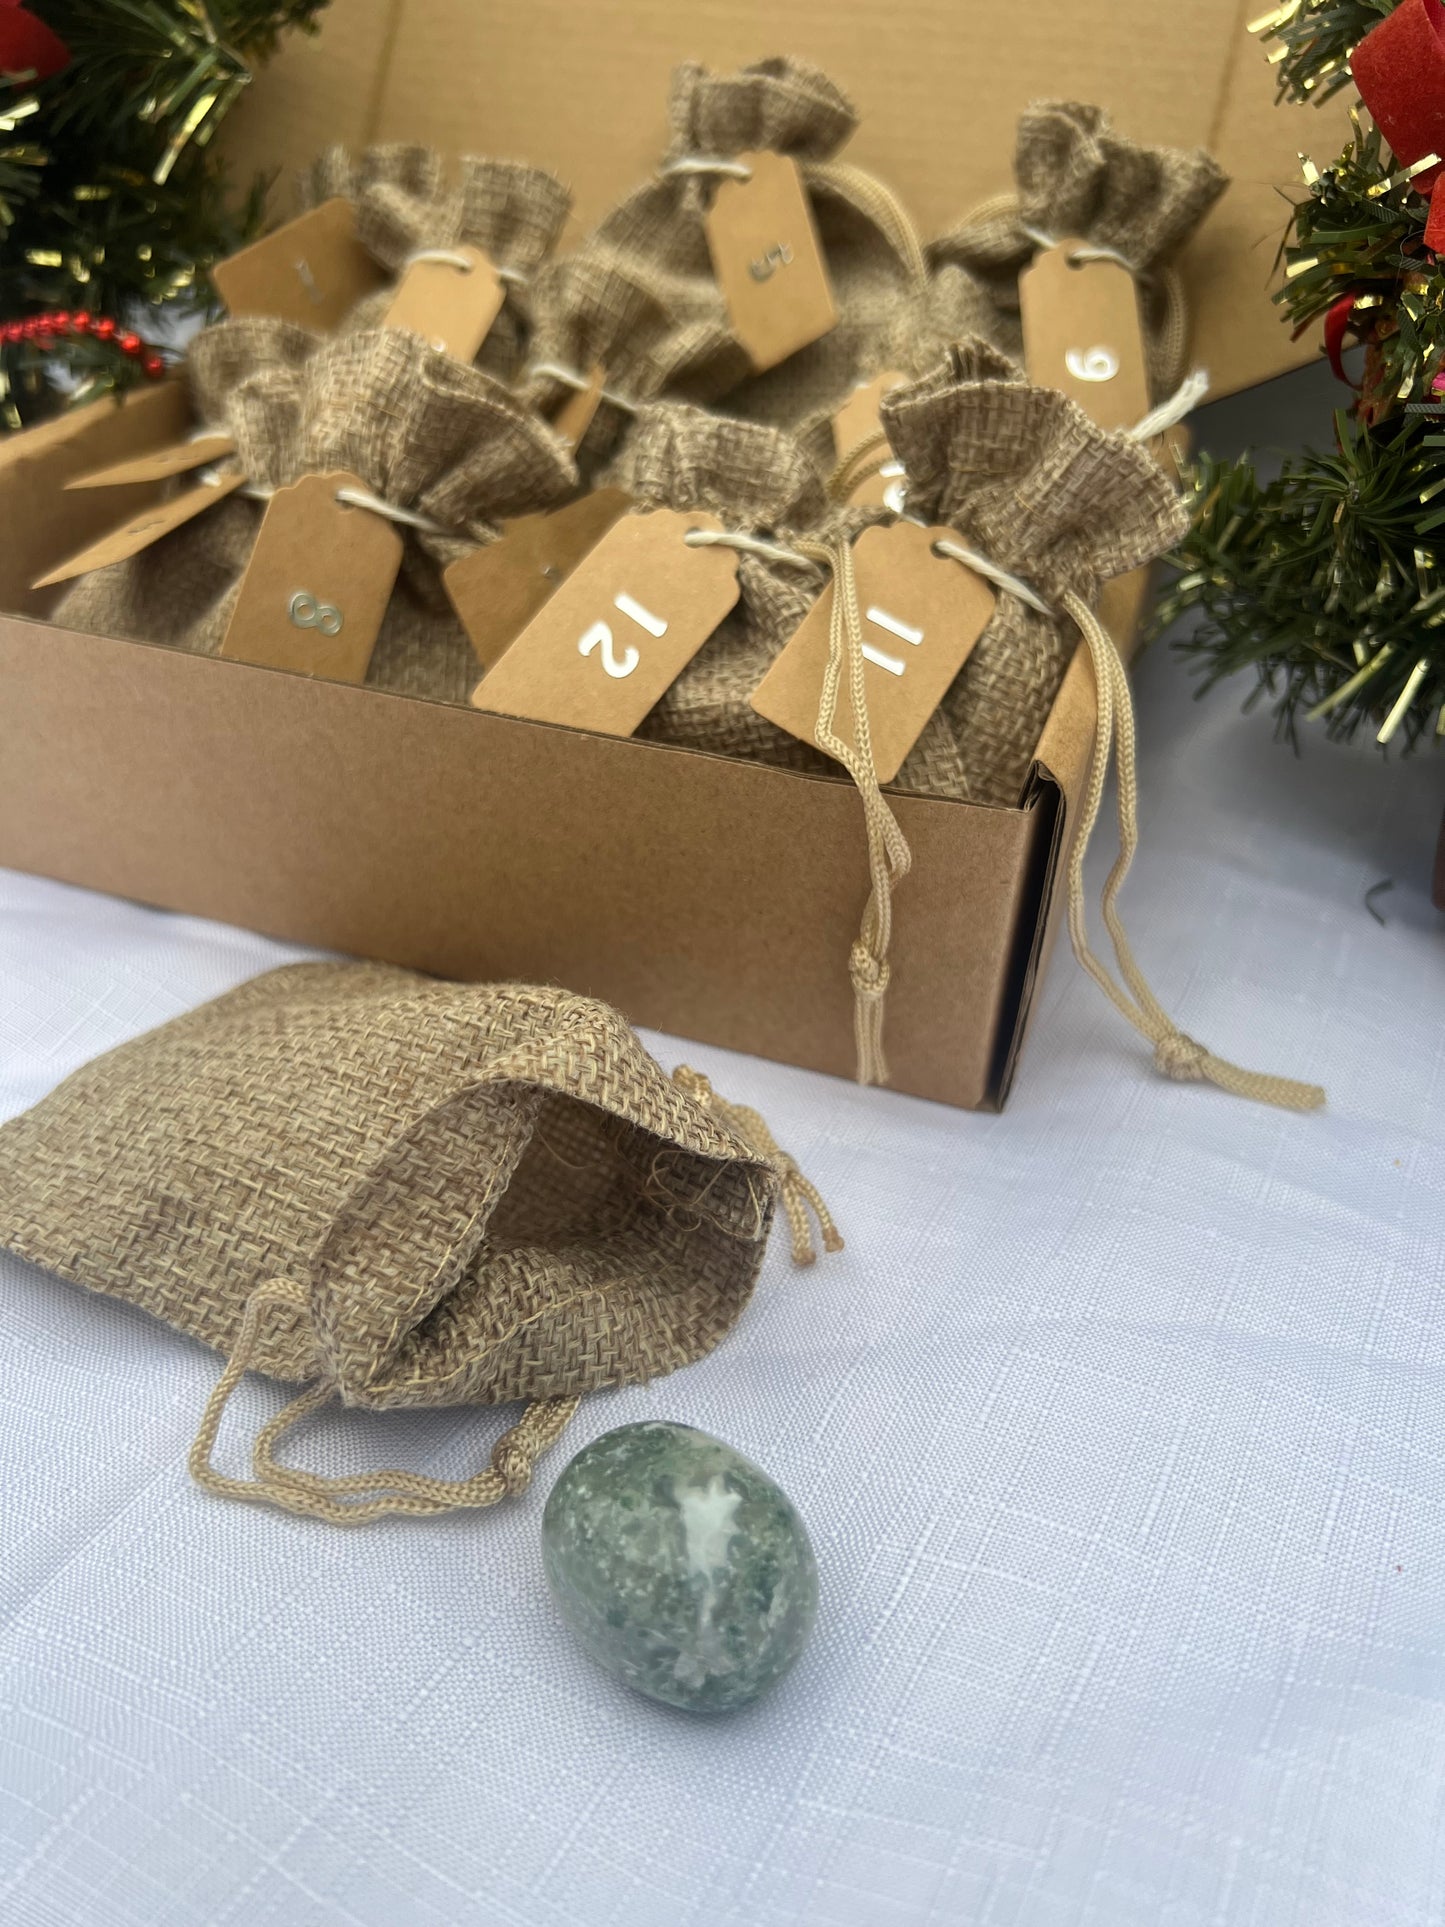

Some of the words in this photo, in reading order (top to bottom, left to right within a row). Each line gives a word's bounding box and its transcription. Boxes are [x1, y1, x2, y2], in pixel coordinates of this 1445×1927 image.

[290, 592, 344, 637] 8
[578, 592, 668, 678] 12
[861, 606, 924, 677] 11
